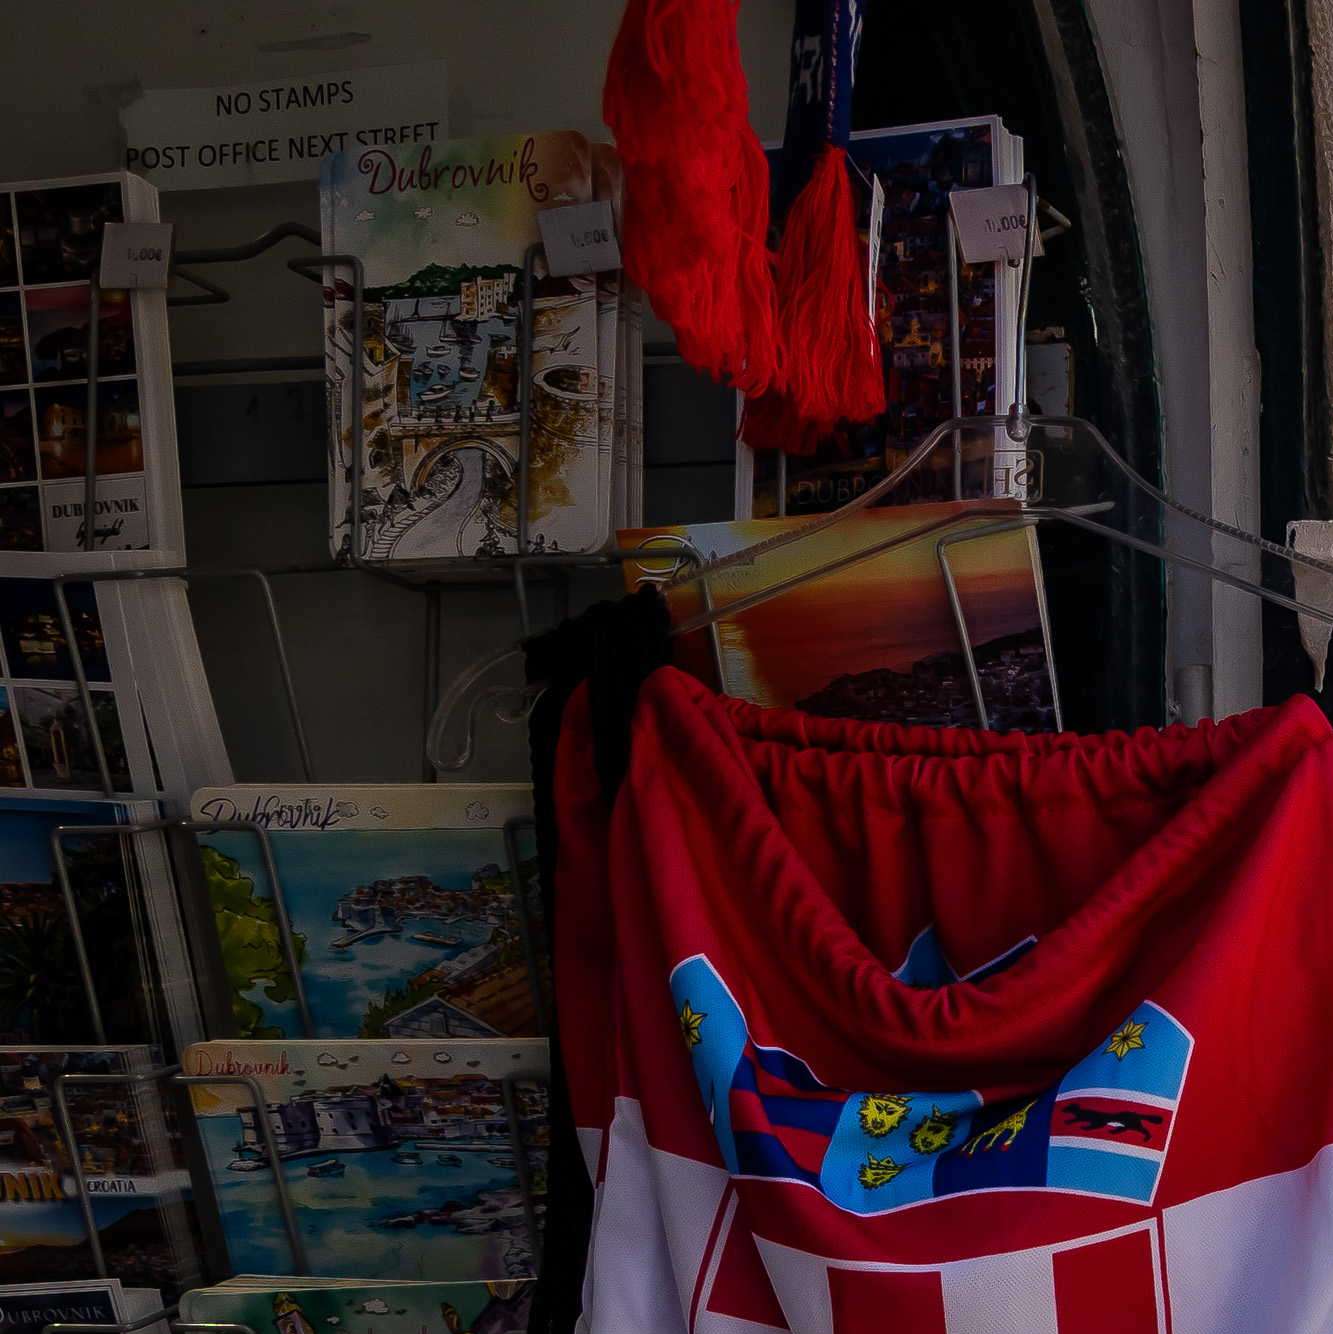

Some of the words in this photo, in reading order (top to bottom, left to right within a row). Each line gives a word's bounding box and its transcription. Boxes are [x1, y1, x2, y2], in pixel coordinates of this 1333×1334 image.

[216, 94, 252, 116] NO
[258, 80, 354, 112] STAMPS
[126, 145, 190, 170] POST
[198, 138, 280, 168] OFFICE
[288, 132, 349, 160] NEXT
[358, 137, 550, 203] Dubrovnik
[797, 470, 950, 505] DUBRNIK
[52, 499, 141, 518] DUBOVNIK
[196, 1049, 292, 1076] Dubrovnik
[87, 1180, 137, 1194] CROATIA
